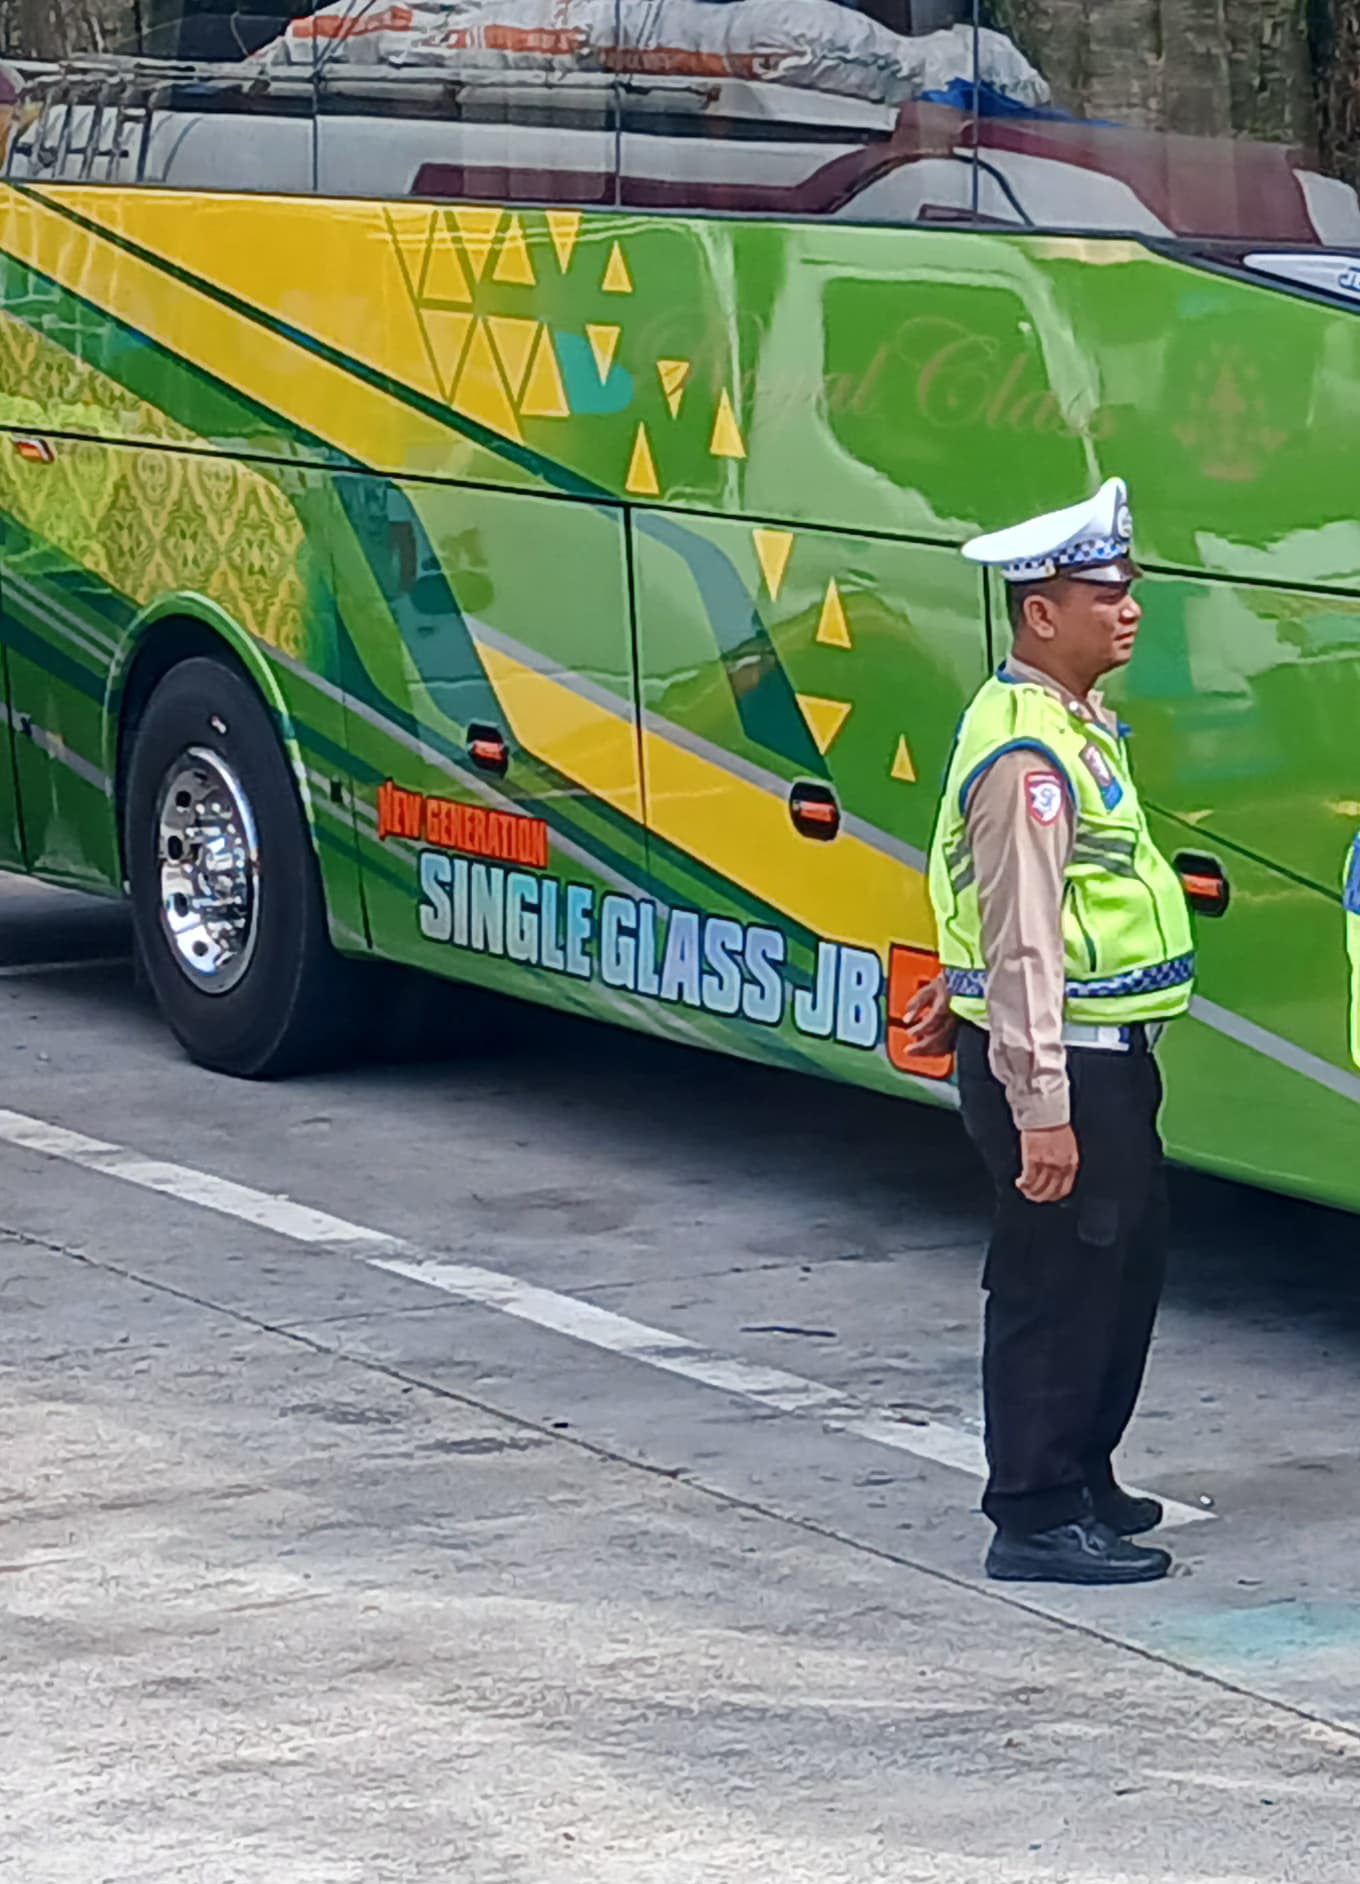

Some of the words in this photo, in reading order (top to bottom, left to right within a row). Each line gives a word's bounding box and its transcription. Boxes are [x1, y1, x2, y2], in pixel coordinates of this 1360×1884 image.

[377, 779, 422, 840] NEW
[425, 796, 548, 868] GENERATION
[418, 851, 594, 979] SINGLE
[601, 893, 785, 1025] GLASS
